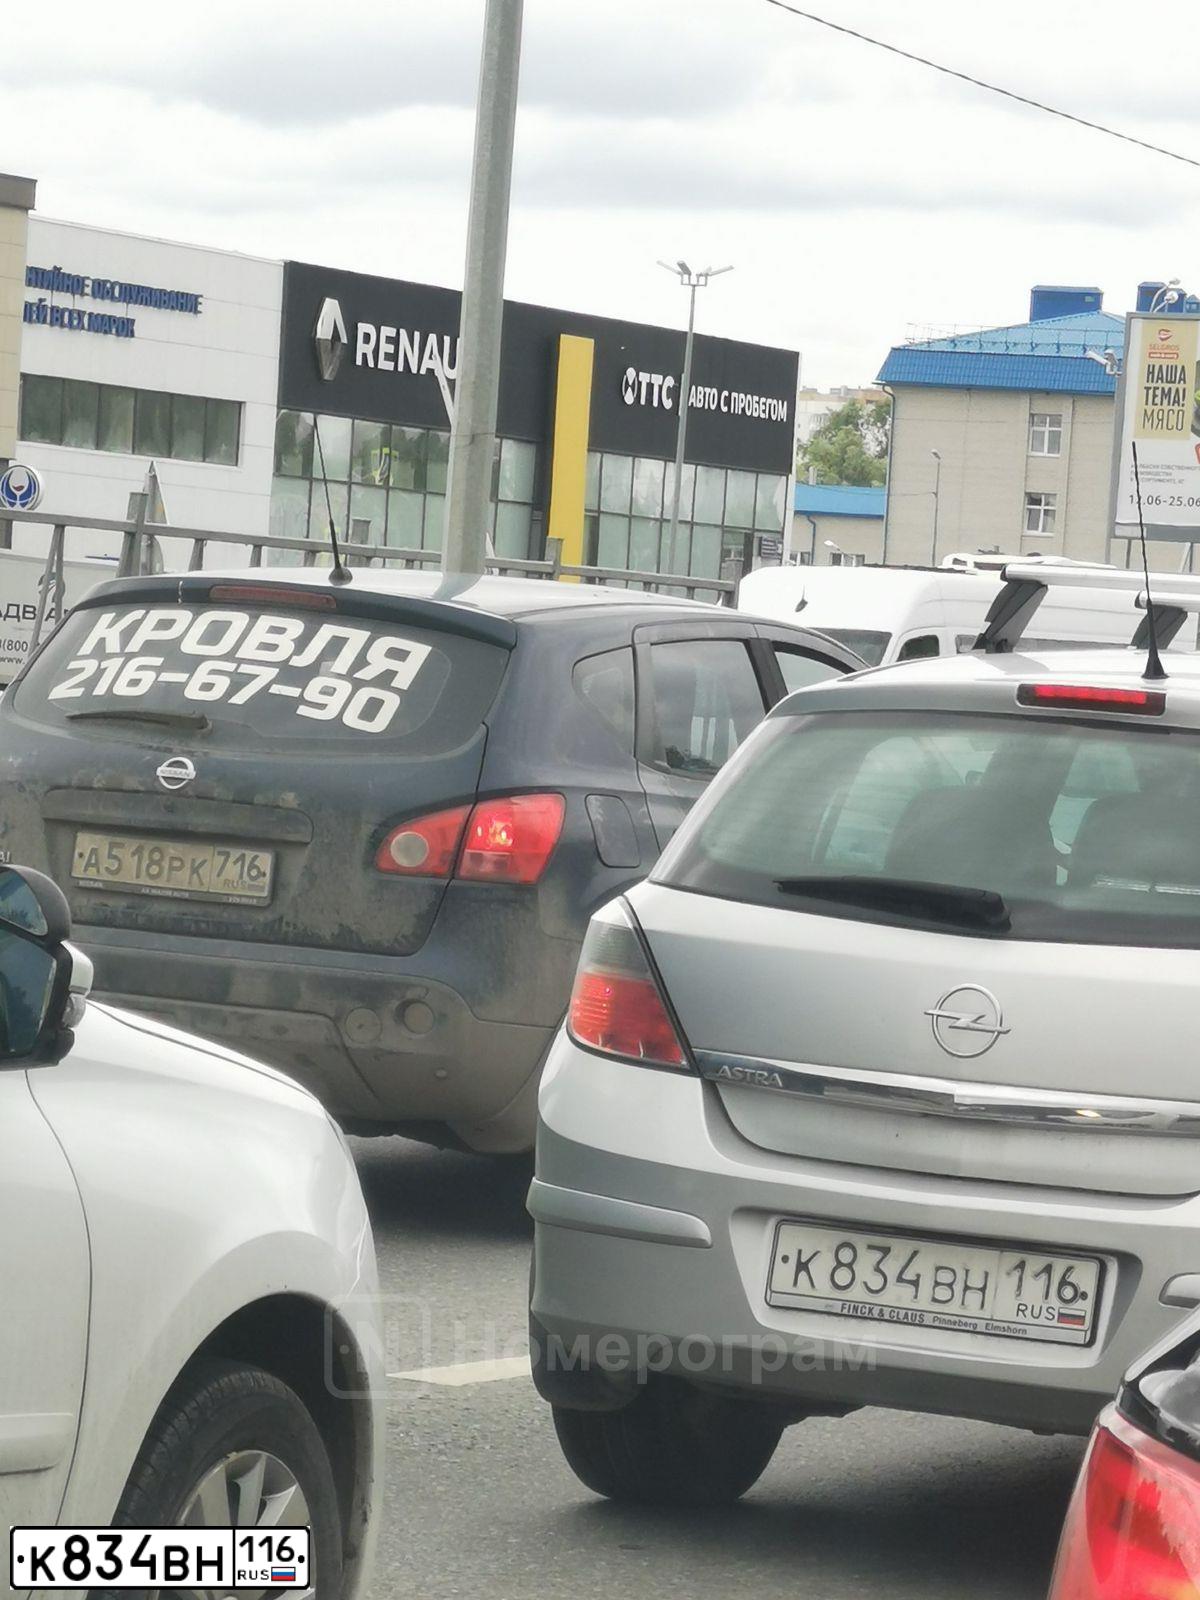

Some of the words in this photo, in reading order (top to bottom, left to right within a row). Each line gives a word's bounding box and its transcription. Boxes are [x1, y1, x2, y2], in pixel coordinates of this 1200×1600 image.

[25, 265, 91, 296] НТИЙНОЕ
[92, 278, 203, 315] ОБСЛУЖИВАНИЕ
[50, 305, 86, 330] ВСЕХ
[88, 312, 136, 337] МАРОК
[356, 322, 461, 379] RENAU
[638, 371, 675, 410] ТТС
[1146, 364, 1186, 384] НАША
[688, 385, 718, 410] АВТО
[720, 390, 729, 412] С
[731, 392, 788, 422] ПРОБЕГОМ
[1144, 386, 1186, 407] ТЕМА!
[1142, 408, 1185, 431] МЯСО
[77, 609, 432, 691] КРОВЛЯ
[48, 656, 401, 734] 216-67-90
[216, 850, 262, 882] 716
[223, 878, 248, 890] RUS
[719, 1065, 783, 1088] ASTRA
[1006, 1258, 1081, 1306] 116
[840, 1302, 878, 1317] FINCK
[878, 1307, 886, 1319] &
[888, 1308, 926, 1324] CLAUS
[932, 1315, 979, 1331] Pinneberg
[985, 1322, 1028, 1336] Elmshorn
[1016, 1303, 1056, 1322] RUS
